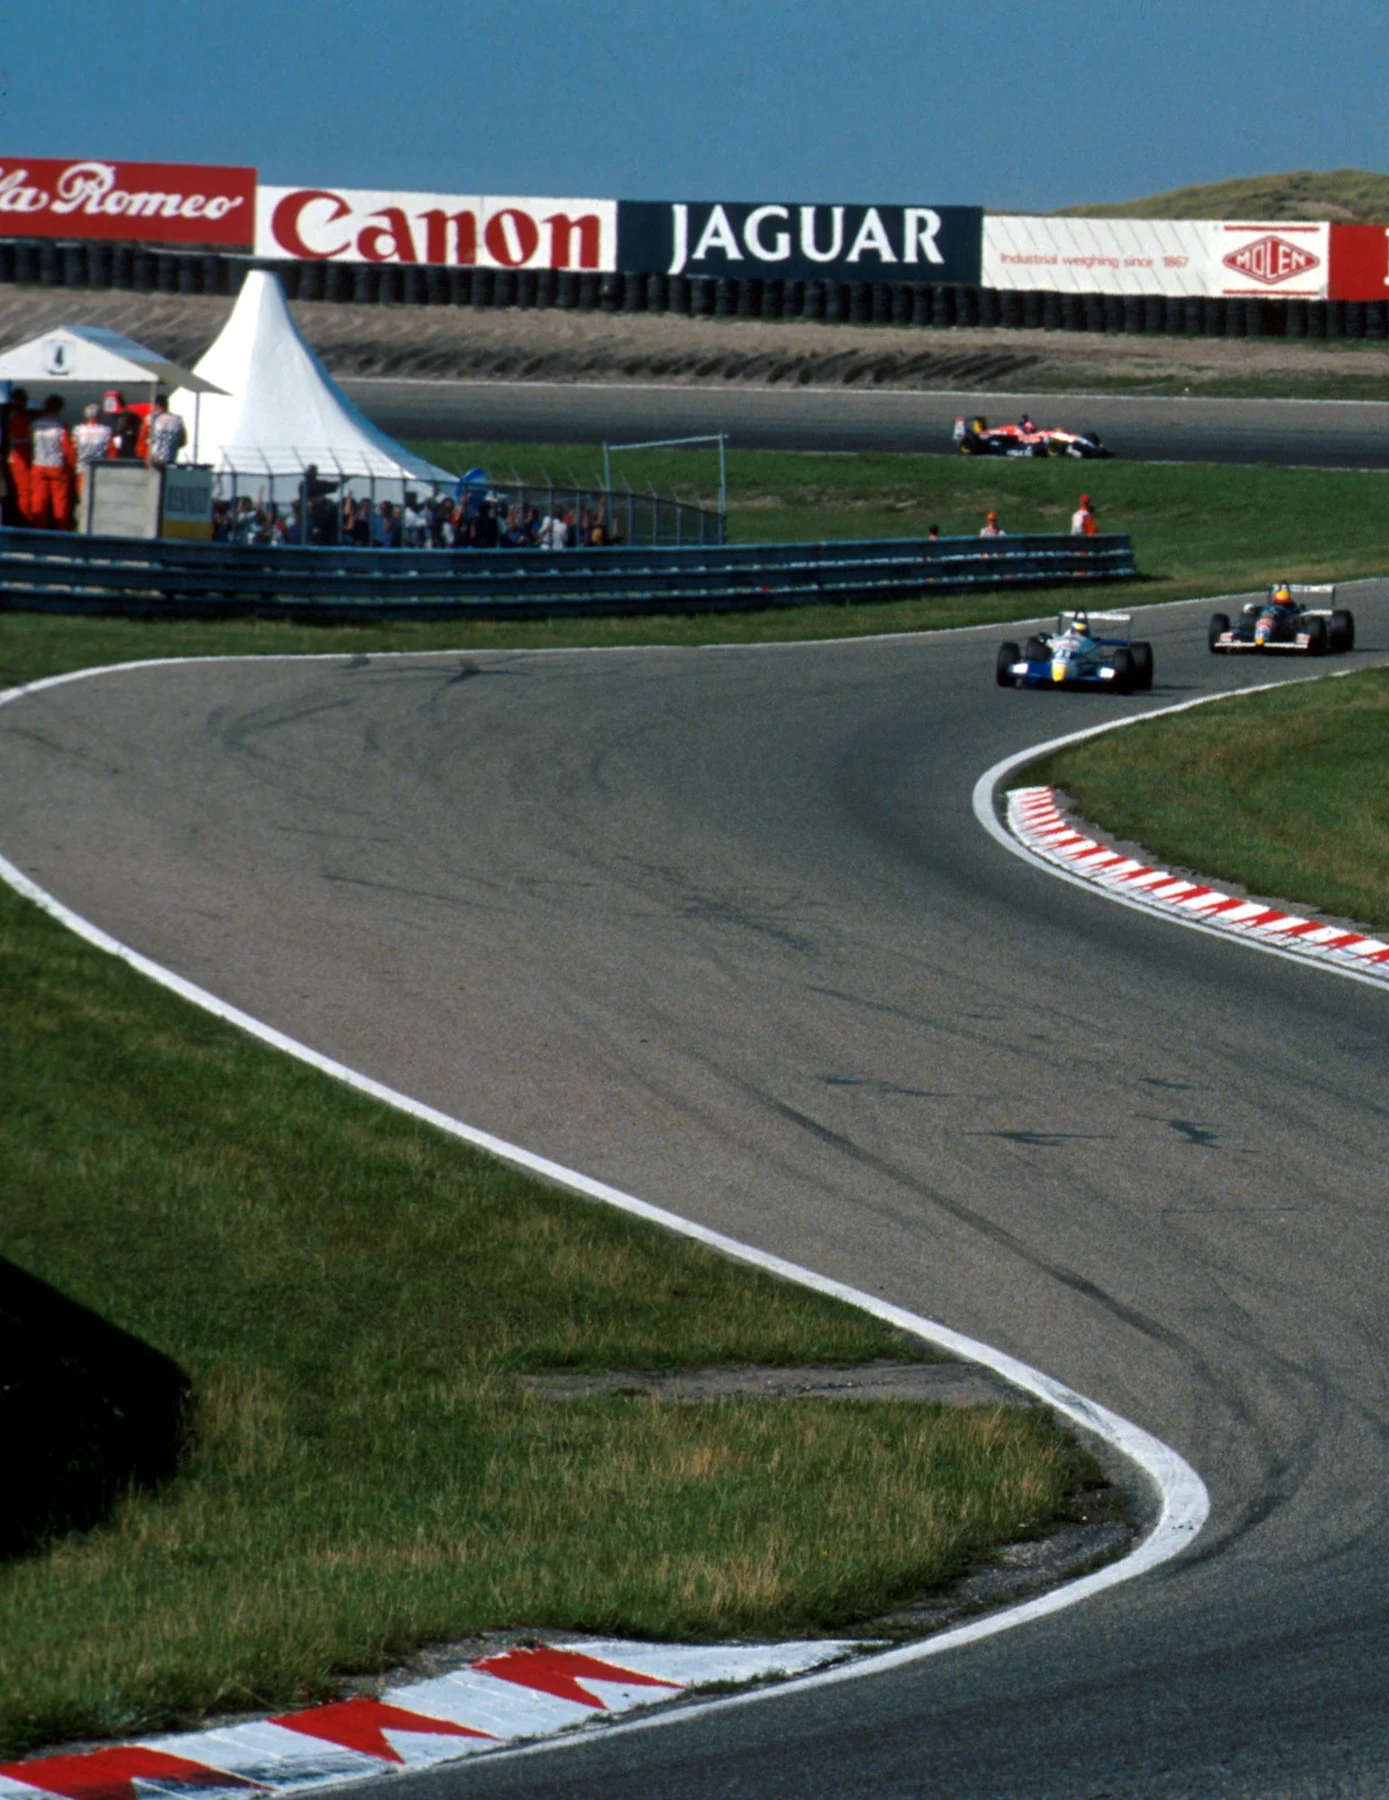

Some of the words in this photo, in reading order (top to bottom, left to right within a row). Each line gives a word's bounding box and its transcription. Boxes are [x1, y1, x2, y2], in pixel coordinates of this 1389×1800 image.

[50, 161, 244, 220] Romeo
[271, 189, 600, 269] Canon
[667, 204, 946, 275] JAGUAR
[1000, 252, 1058, 265] Industrial
[1063, 254, 1120, 269] weighing
[1124, 256, 1154, 268] since
[1236, 244, 1307, 280] MOLEN
